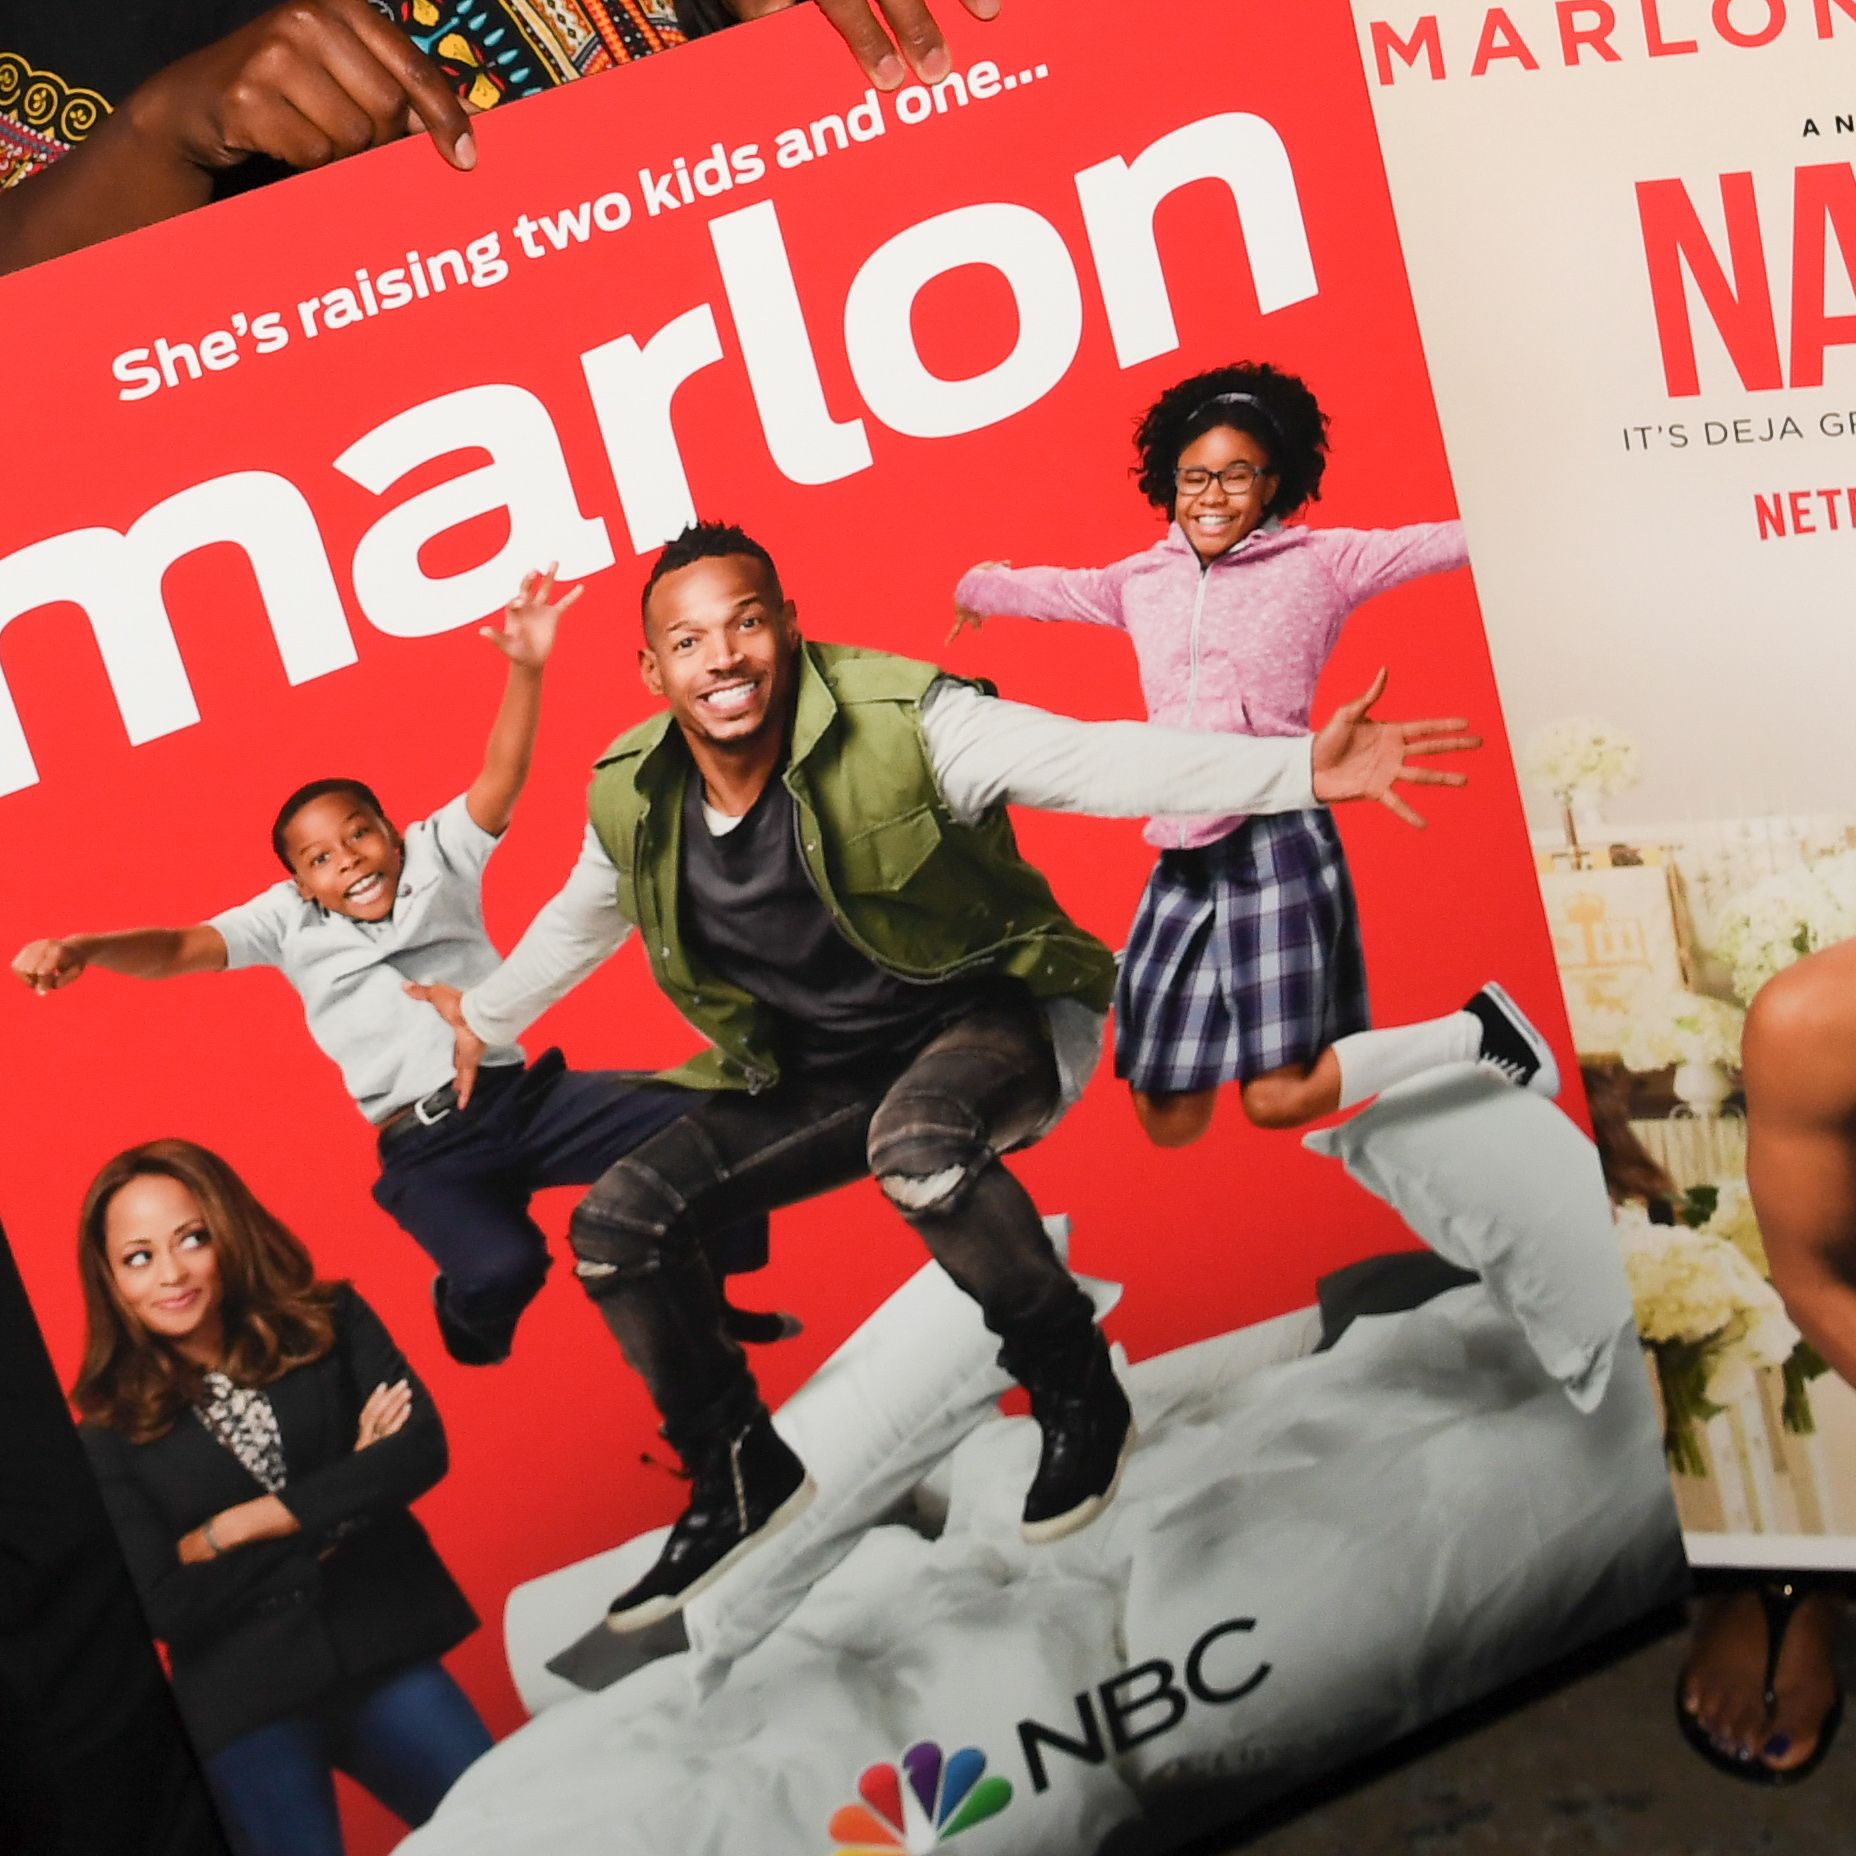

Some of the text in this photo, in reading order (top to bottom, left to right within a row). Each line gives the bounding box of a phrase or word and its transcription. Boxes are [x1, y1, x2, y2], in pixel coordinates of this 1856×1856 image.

[1802, 118, 1820, 137] A
[112, 60, 1049, 401] She's raising two kids and one...
[1623, 422, 1690, 450] IT'S
[1704, 416, 1804, 446] DEJA
[1016, 1617, 1272, 1794] NBC
